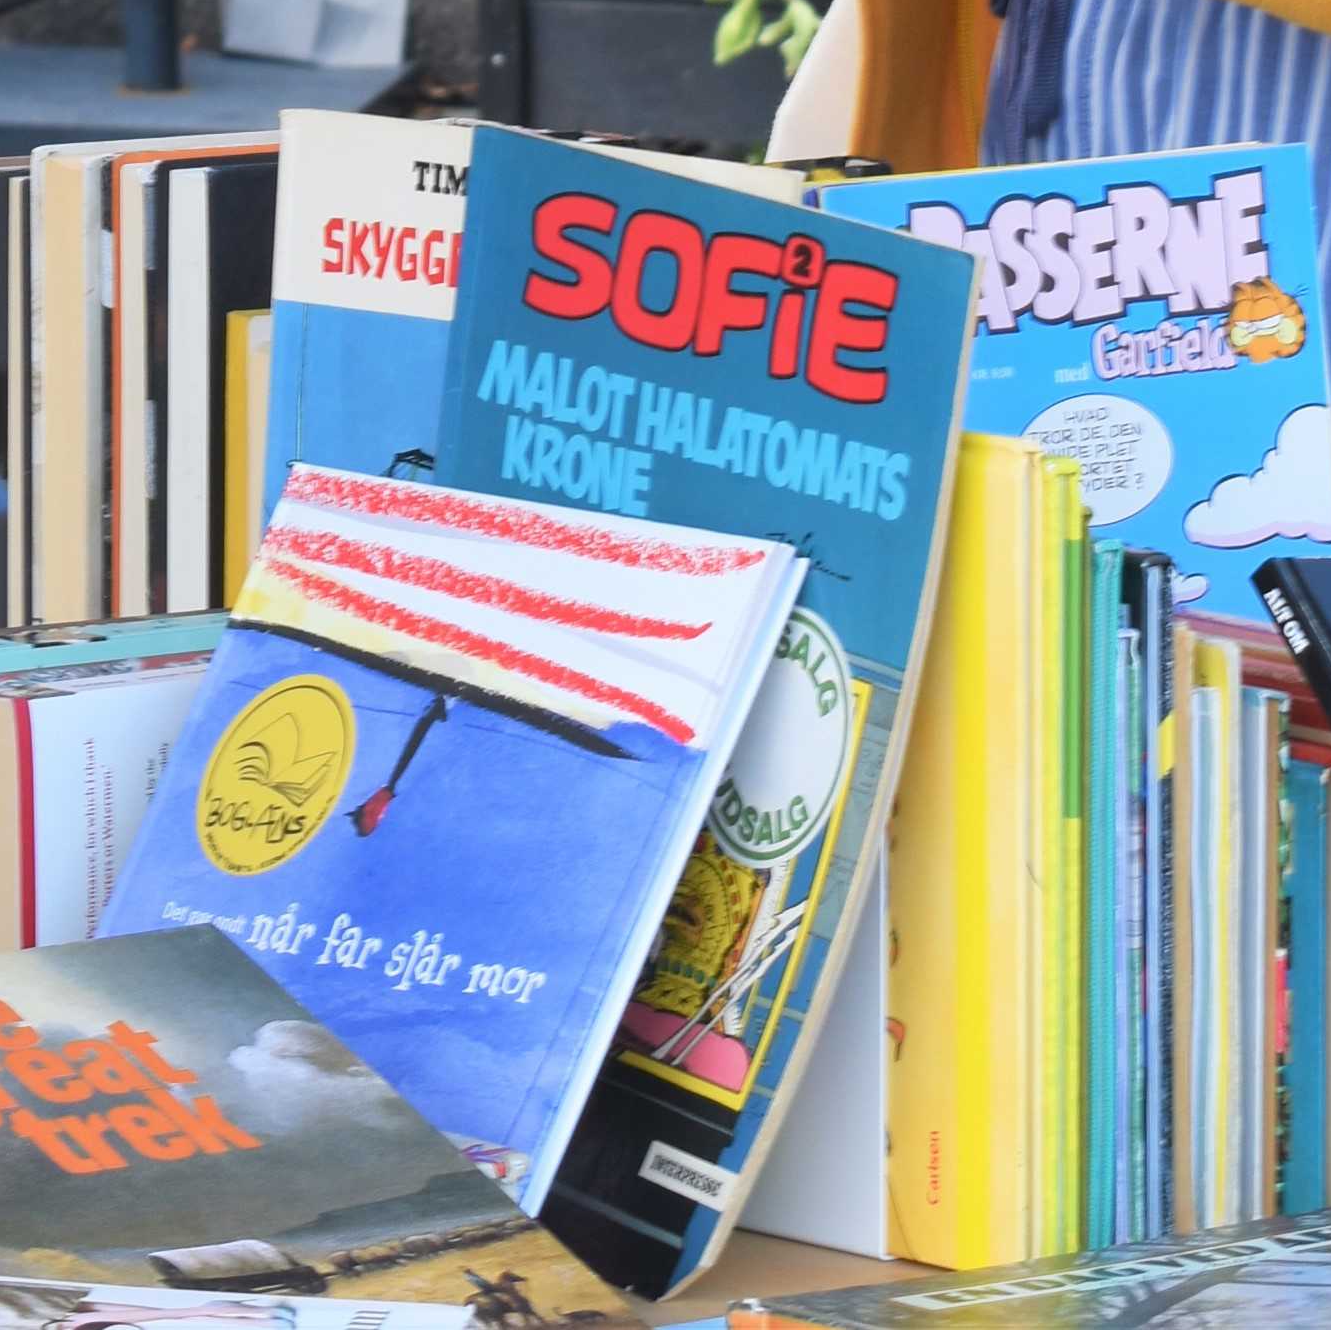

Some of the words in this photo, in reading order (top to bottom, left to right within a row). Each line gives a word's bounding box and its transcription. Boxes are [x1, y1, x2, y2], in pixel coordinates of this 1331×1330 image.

[1091, 315, 1240, 382] Garfield
[477, 339, 636, 433] MALOT
[635, 384, 914, 523] HALATOMATS
[1061, 406, 1112, 424] HVAD
[1108, 421, 1144, 440] DEN
[501, 414, 657, 519] KRONE
[1283, 618, 1313, 657] OM
[246, 902, 318, 956] når
[315, 912, 384, 970] far
[383, 928, 463, 991] slår
[461, 962, 548, 1004] mor
[10, 1087, 265, 1176] trek
[925, 1129, 941, 1207] Carlsen
